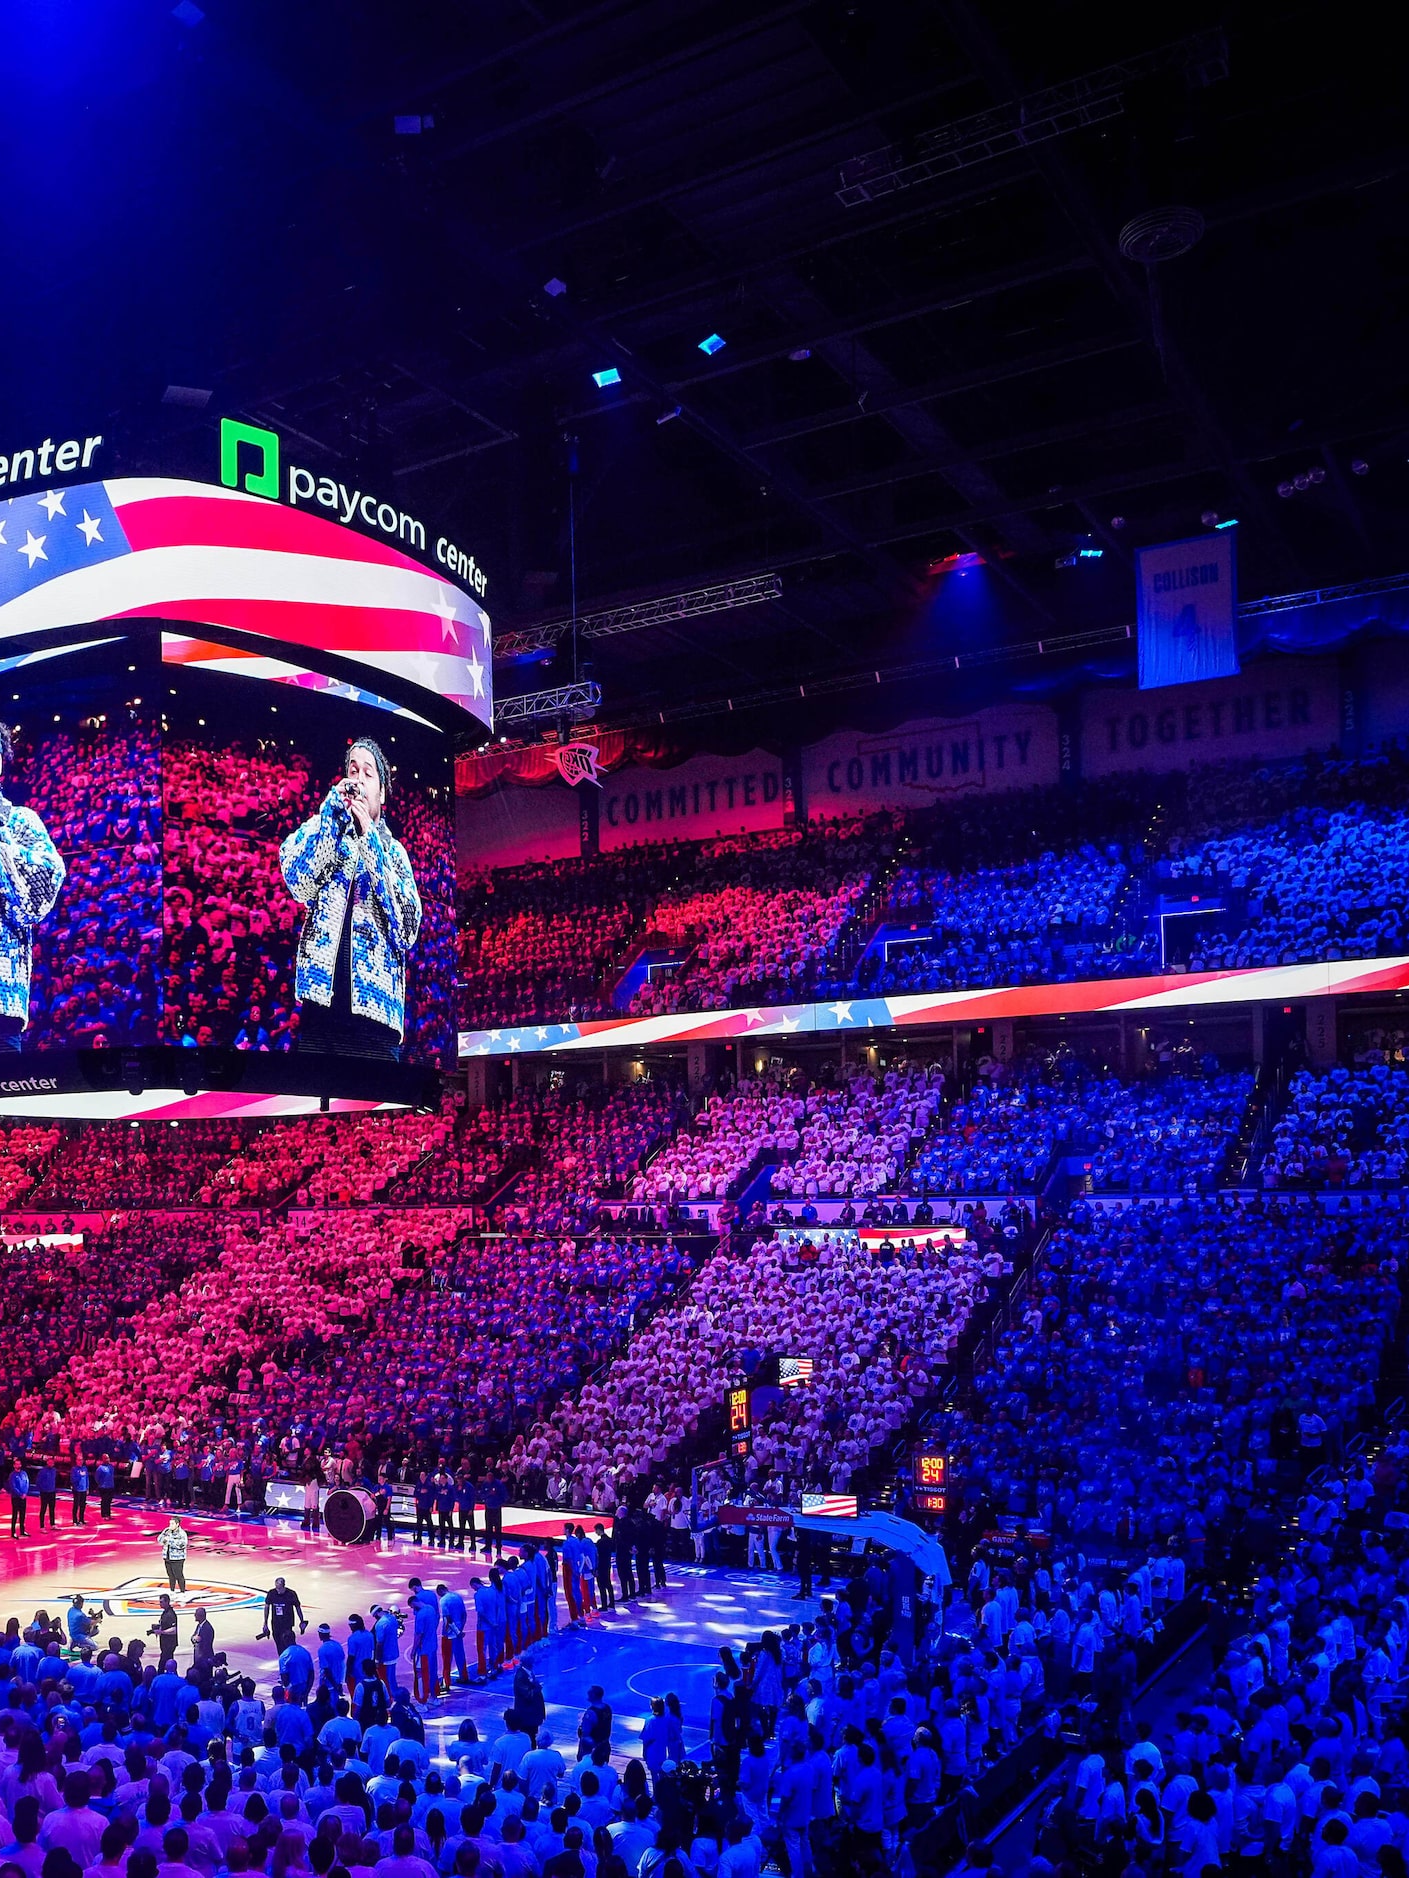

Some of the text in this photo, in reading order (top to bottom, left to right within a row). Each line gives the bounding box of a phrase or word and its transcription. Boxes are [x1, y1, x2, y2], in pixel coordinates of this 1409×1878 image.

[289, 465, 489, 599] paycom center
[1153, 563, 1219, 595] COLLISON
[1173, 604, 1201, 652] 4
[1102, 688, 1310, 750] TOGETHER
[828, 732, 1032, 793] COMMUNITY
[1061, 734, 1072, 771] 324
[607, 771, 779, 827] COMMITTED
[580, 808, 590, 842] 322
[0, 1076, 58, 1093] center
[731, 1404, 747, 1429] 24
[922, 1457, 944, 1470] 12:00
[922, 1468, 939, 1482] 24
[927, 1497, 944, 1509] 1:30
